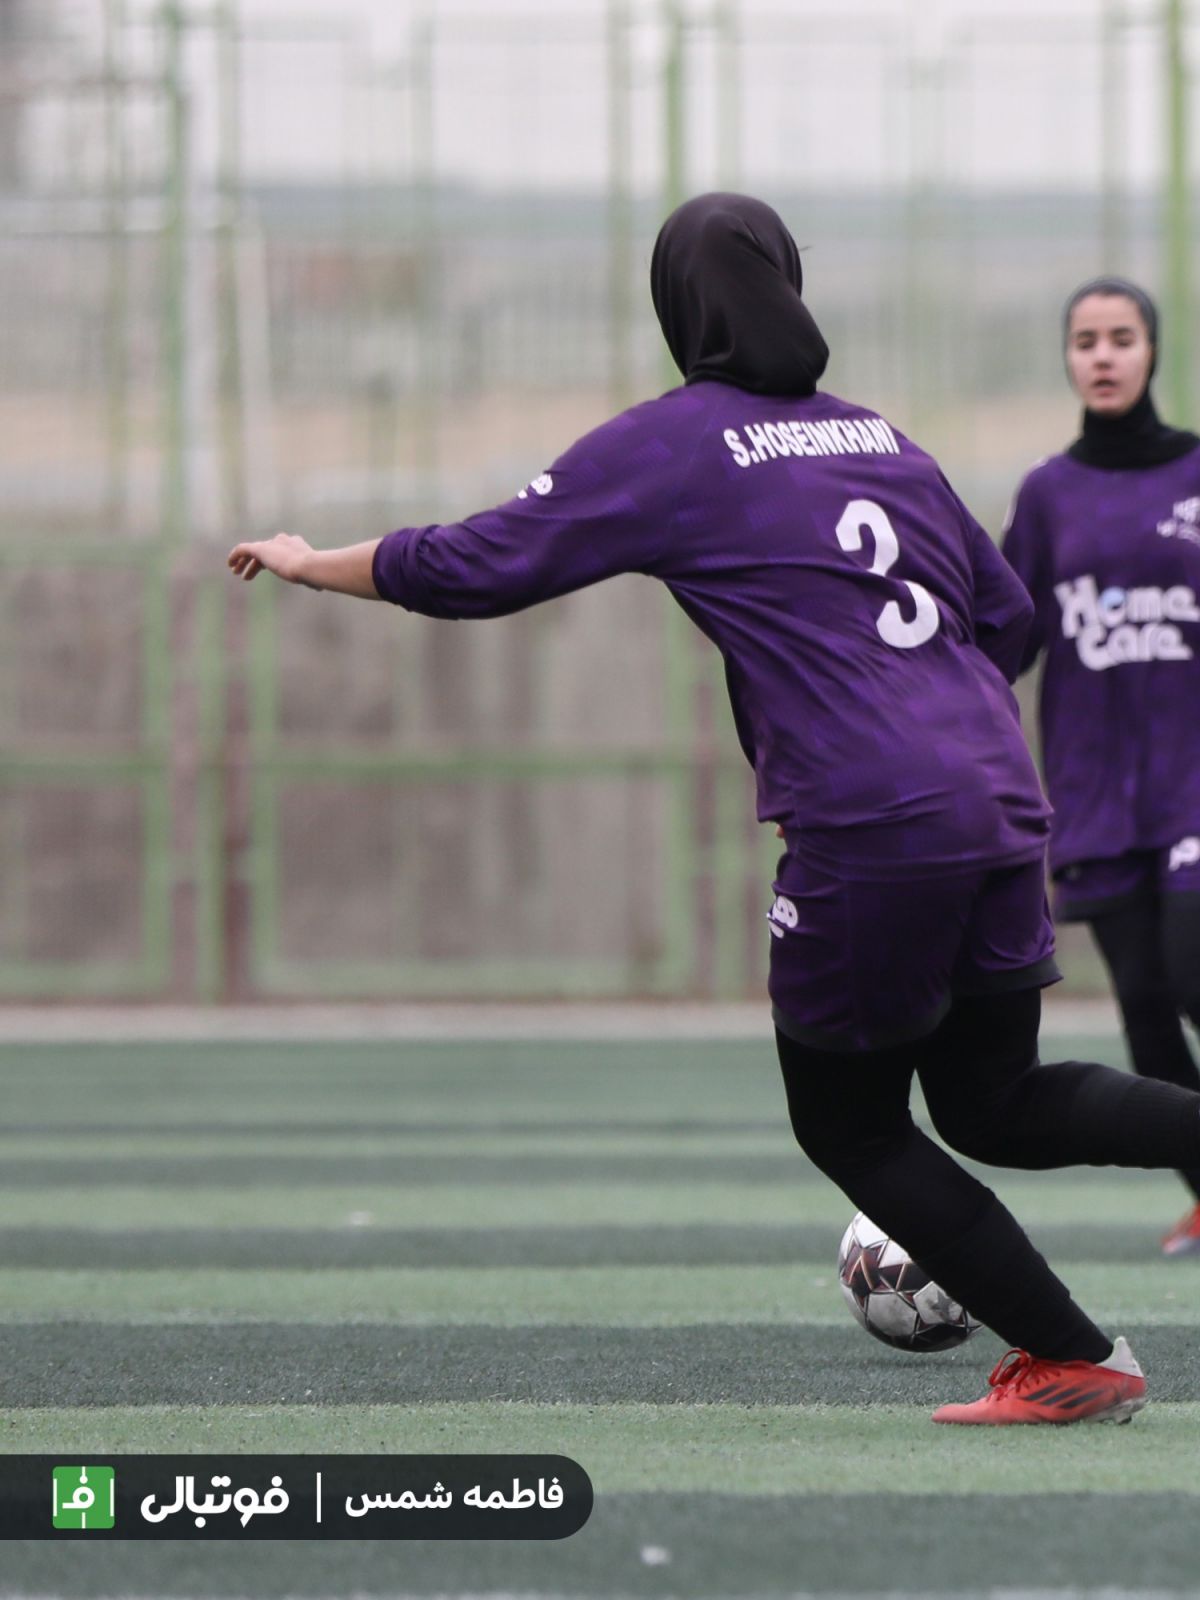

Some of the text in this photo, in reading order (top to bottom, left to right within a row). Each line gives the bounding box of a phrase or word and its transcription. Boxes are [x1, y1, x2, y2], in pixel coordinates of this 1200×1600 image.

[723, 418, 900, 468] S.HOSEINKHANI
[835, 499, 940, 649] 3
[1076, 623, 1194, 671] Care
